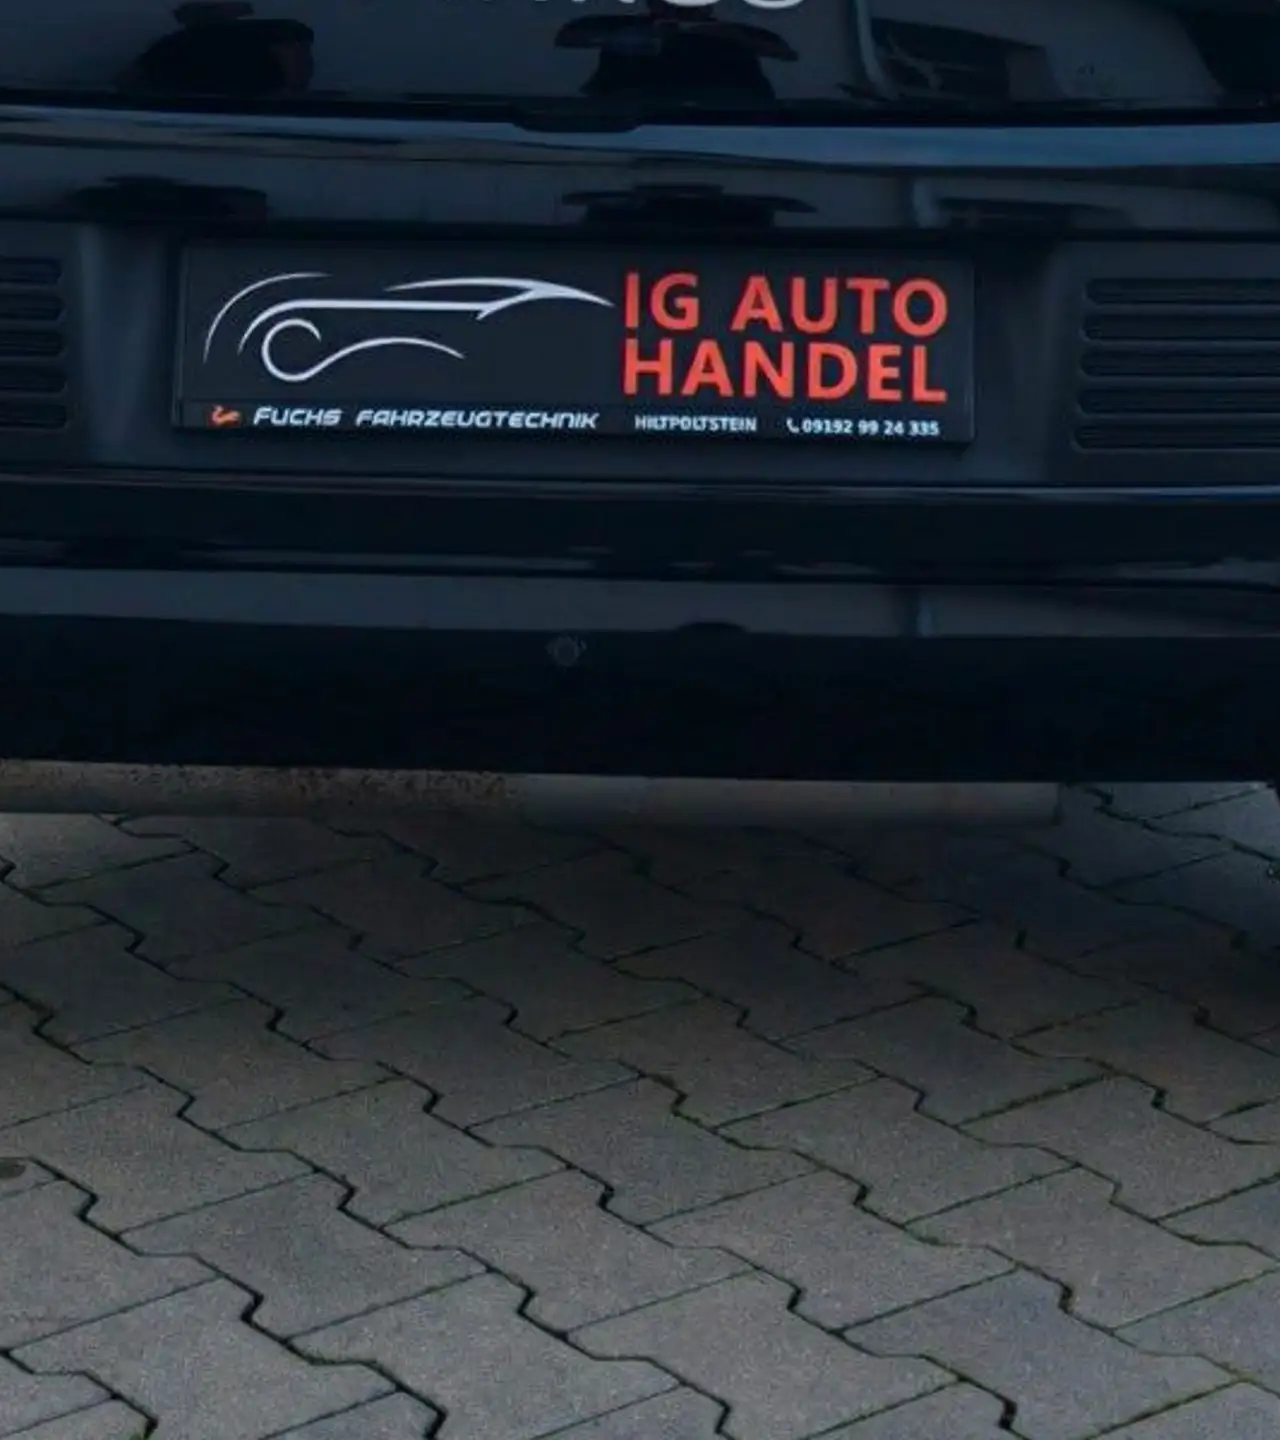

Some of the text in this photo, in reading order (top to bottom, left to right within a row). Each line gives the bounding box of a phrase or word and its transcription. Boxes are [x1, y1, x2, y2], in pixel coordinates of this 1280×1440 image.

[625, 272, 949, 338] IG AUTO
[623, 338, 949, 403] HANDEL
[252, 406, 344, 427] FUCHS
[354, 408, 601, 430] FAHRZEUGTECHNIK
[634, 414, 759, 433] HILTPOLTSTEIN
